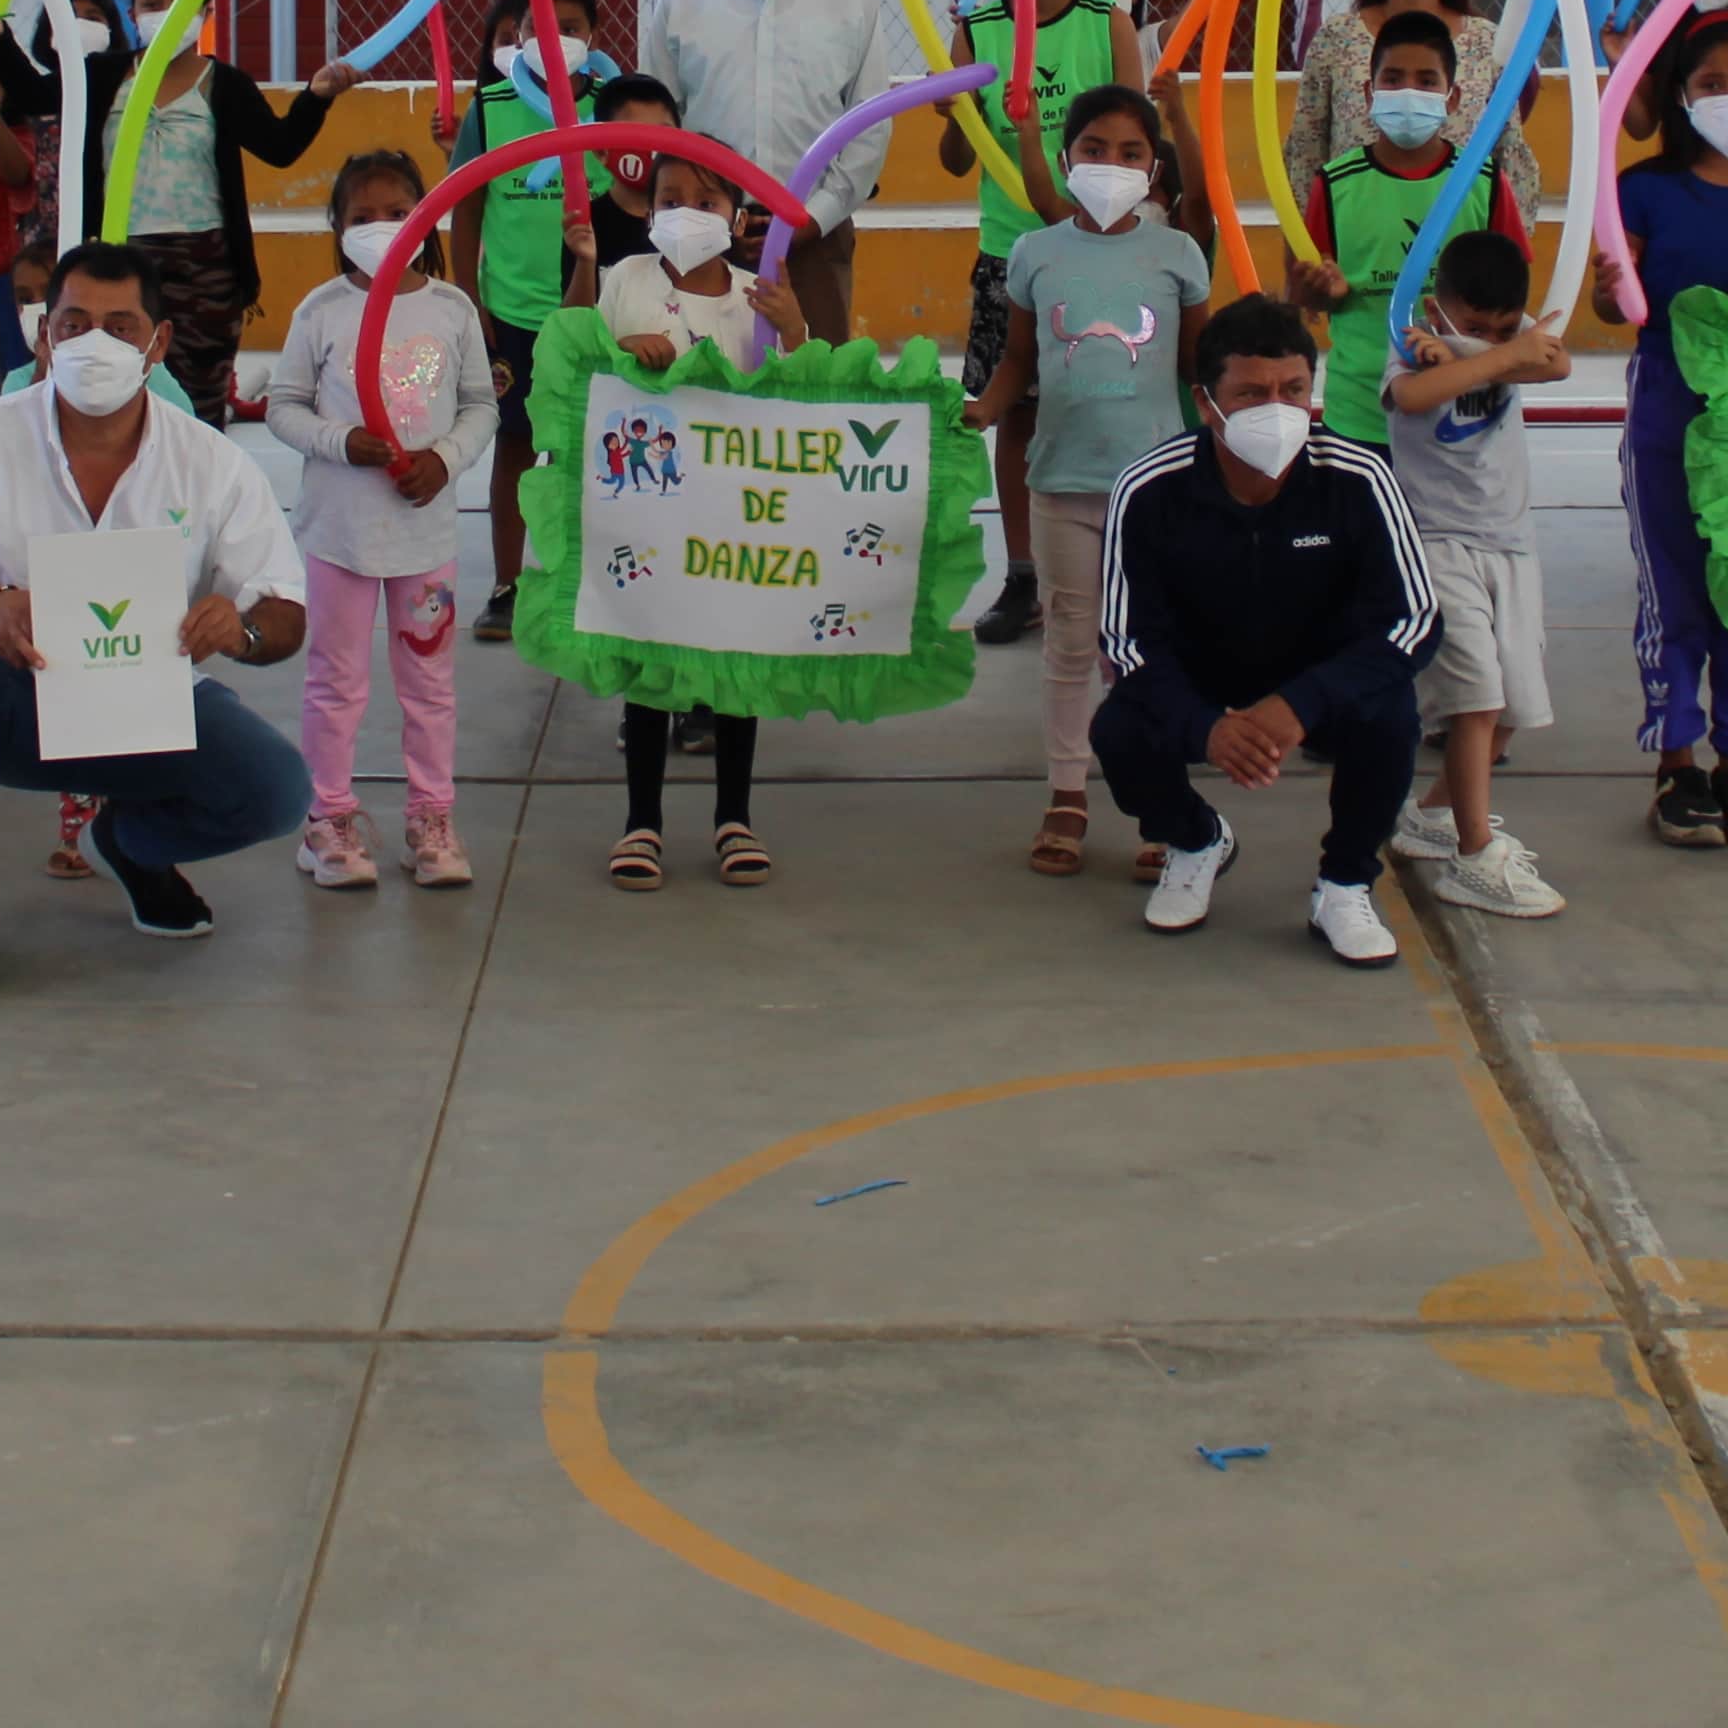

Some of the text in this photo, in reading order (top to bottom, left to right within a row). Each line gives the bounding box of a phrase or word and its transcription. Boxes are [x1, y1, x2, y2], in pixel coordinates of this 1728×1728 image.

[690, 420, 846, 476] TALLER
[742, 487, 790, 524] DE
[684, 535, 822, 588] DANZA
